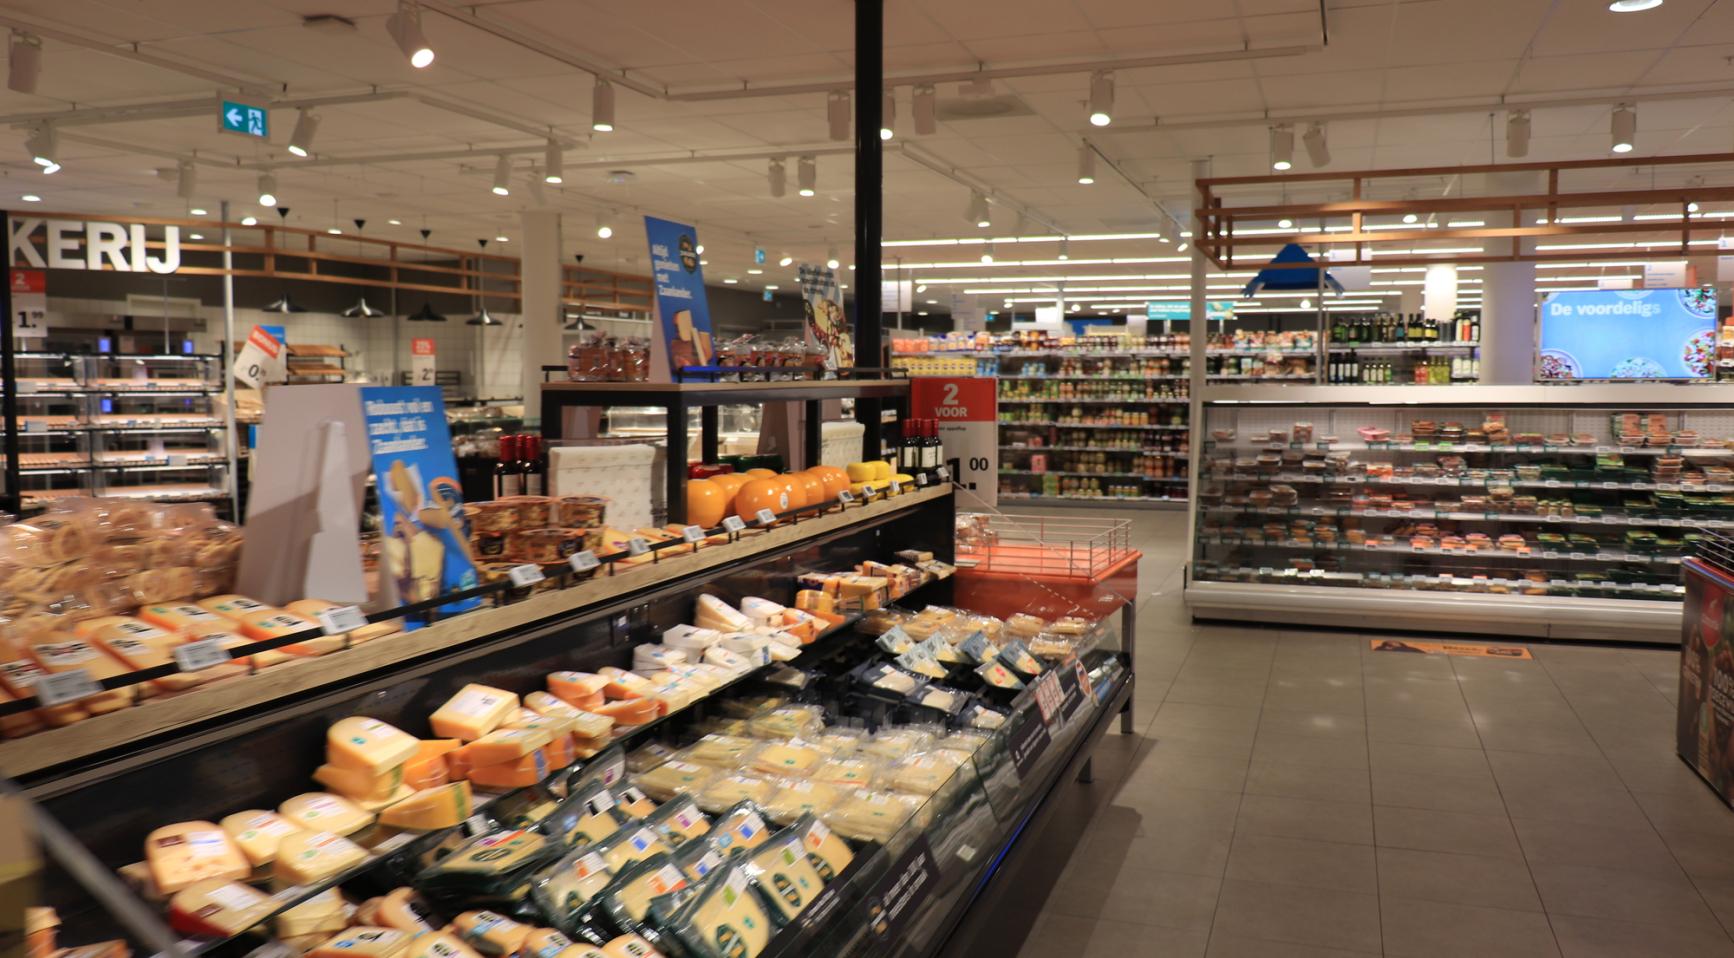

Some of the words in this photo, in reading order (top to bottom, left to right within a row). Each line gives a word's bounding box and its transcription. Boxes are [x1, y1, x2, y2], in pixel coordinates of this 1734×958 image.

[8, 217, 181, 274] KERIJ
[1551, 303, 1572, 316] De
[942, 383, 959, 406] 2
[934, 407, 968, 417] VOOR
